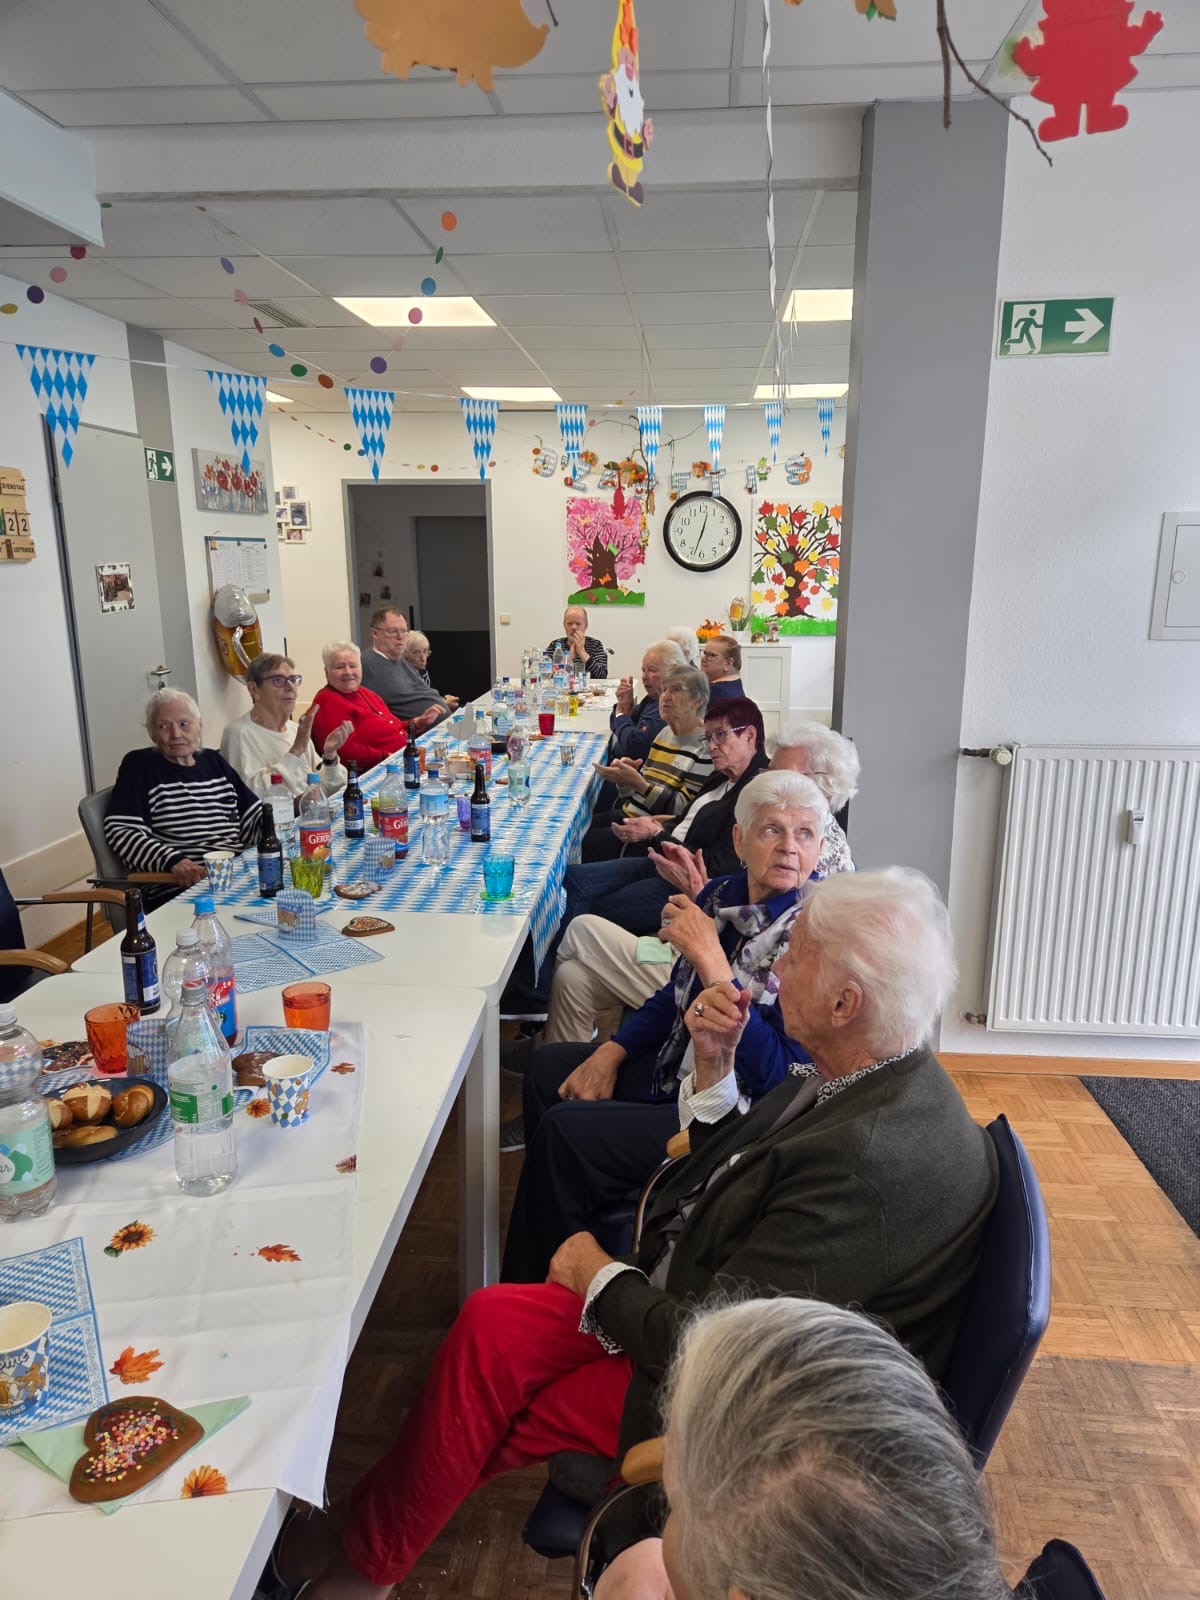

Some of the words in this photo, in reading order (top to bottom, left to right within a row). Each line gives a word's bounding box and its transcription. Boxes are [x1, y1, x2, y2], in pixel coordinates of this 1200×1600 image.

[2, 482, 25, 491] DIENSTAG
[689, 507, 697, 518] 11
[699, 504, 708, 514] 12
[712, 507, 716, 517] 1
[681, 517, 691, 526] 10
[719, 515, 725, 524] 2
[676, 527, 683, 536] 9
[724, 527, 729, 536] 3
[680, 538, 686, 548] 8
[718, 538, 724, 547] 4
[688, 546, 694, 556] 7
[698, 550, 705, 559] 6
[711, 546, 717, 558] 5
